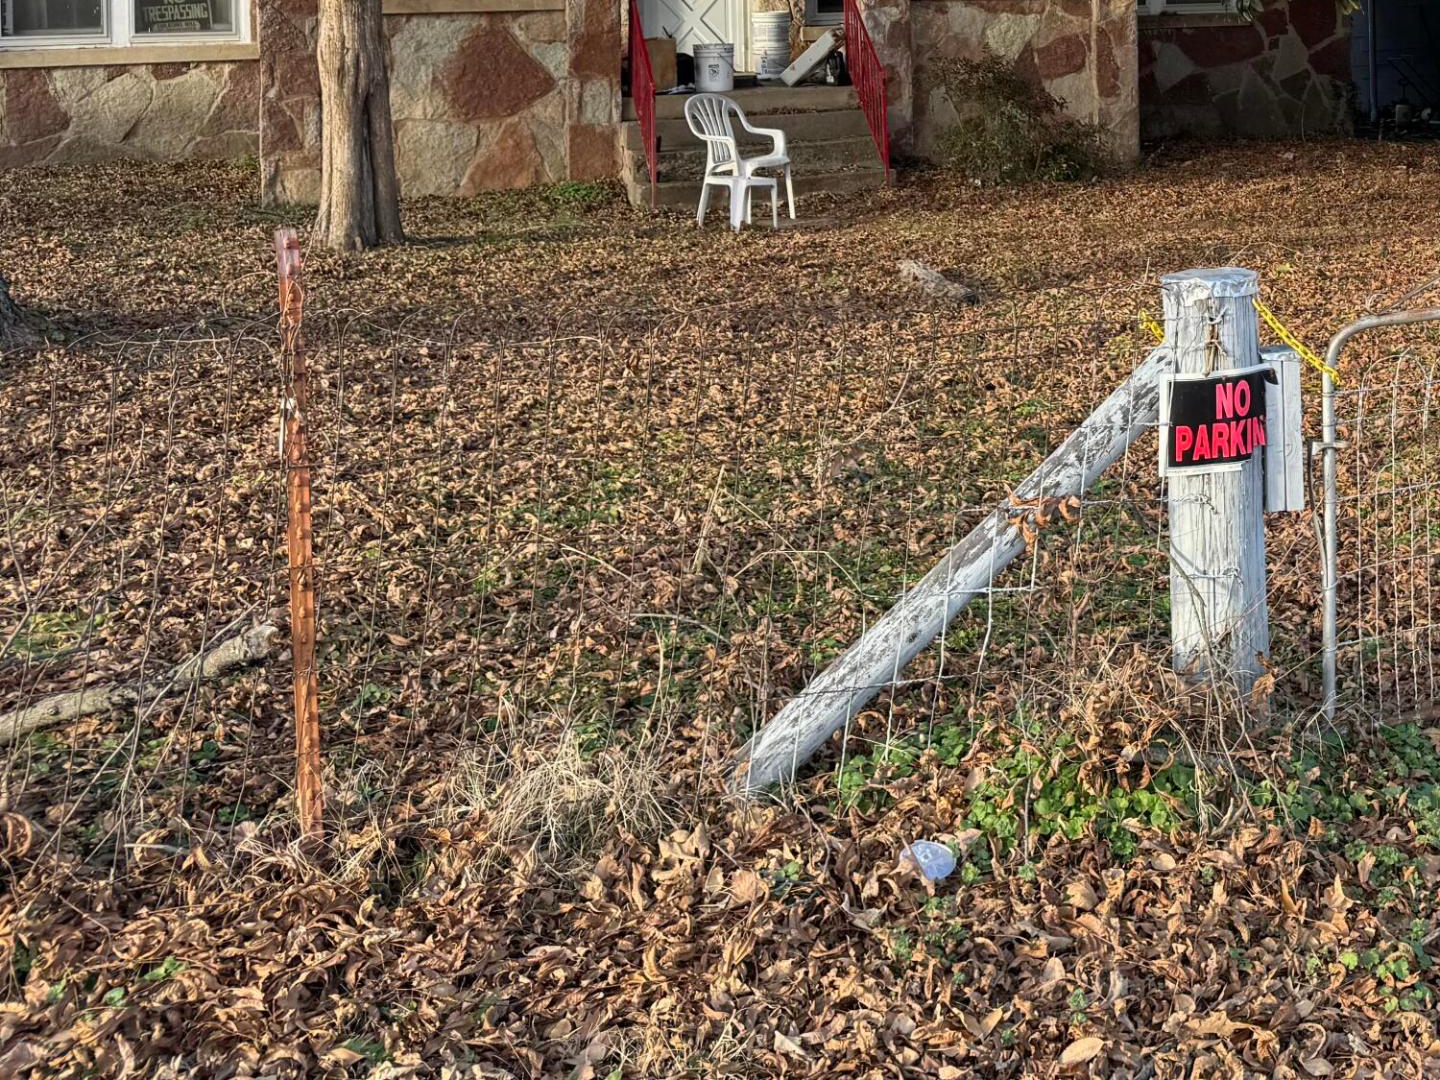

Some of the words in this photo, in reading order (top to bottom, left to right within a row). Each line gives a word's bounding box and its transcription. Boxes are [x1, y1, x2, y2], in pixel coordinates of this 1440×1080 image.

[143, 2, 209, 23] TRESPASSING
[1215, 379, 1251, 419] NO
[1175, 417, 1266, 462] PARKIN
